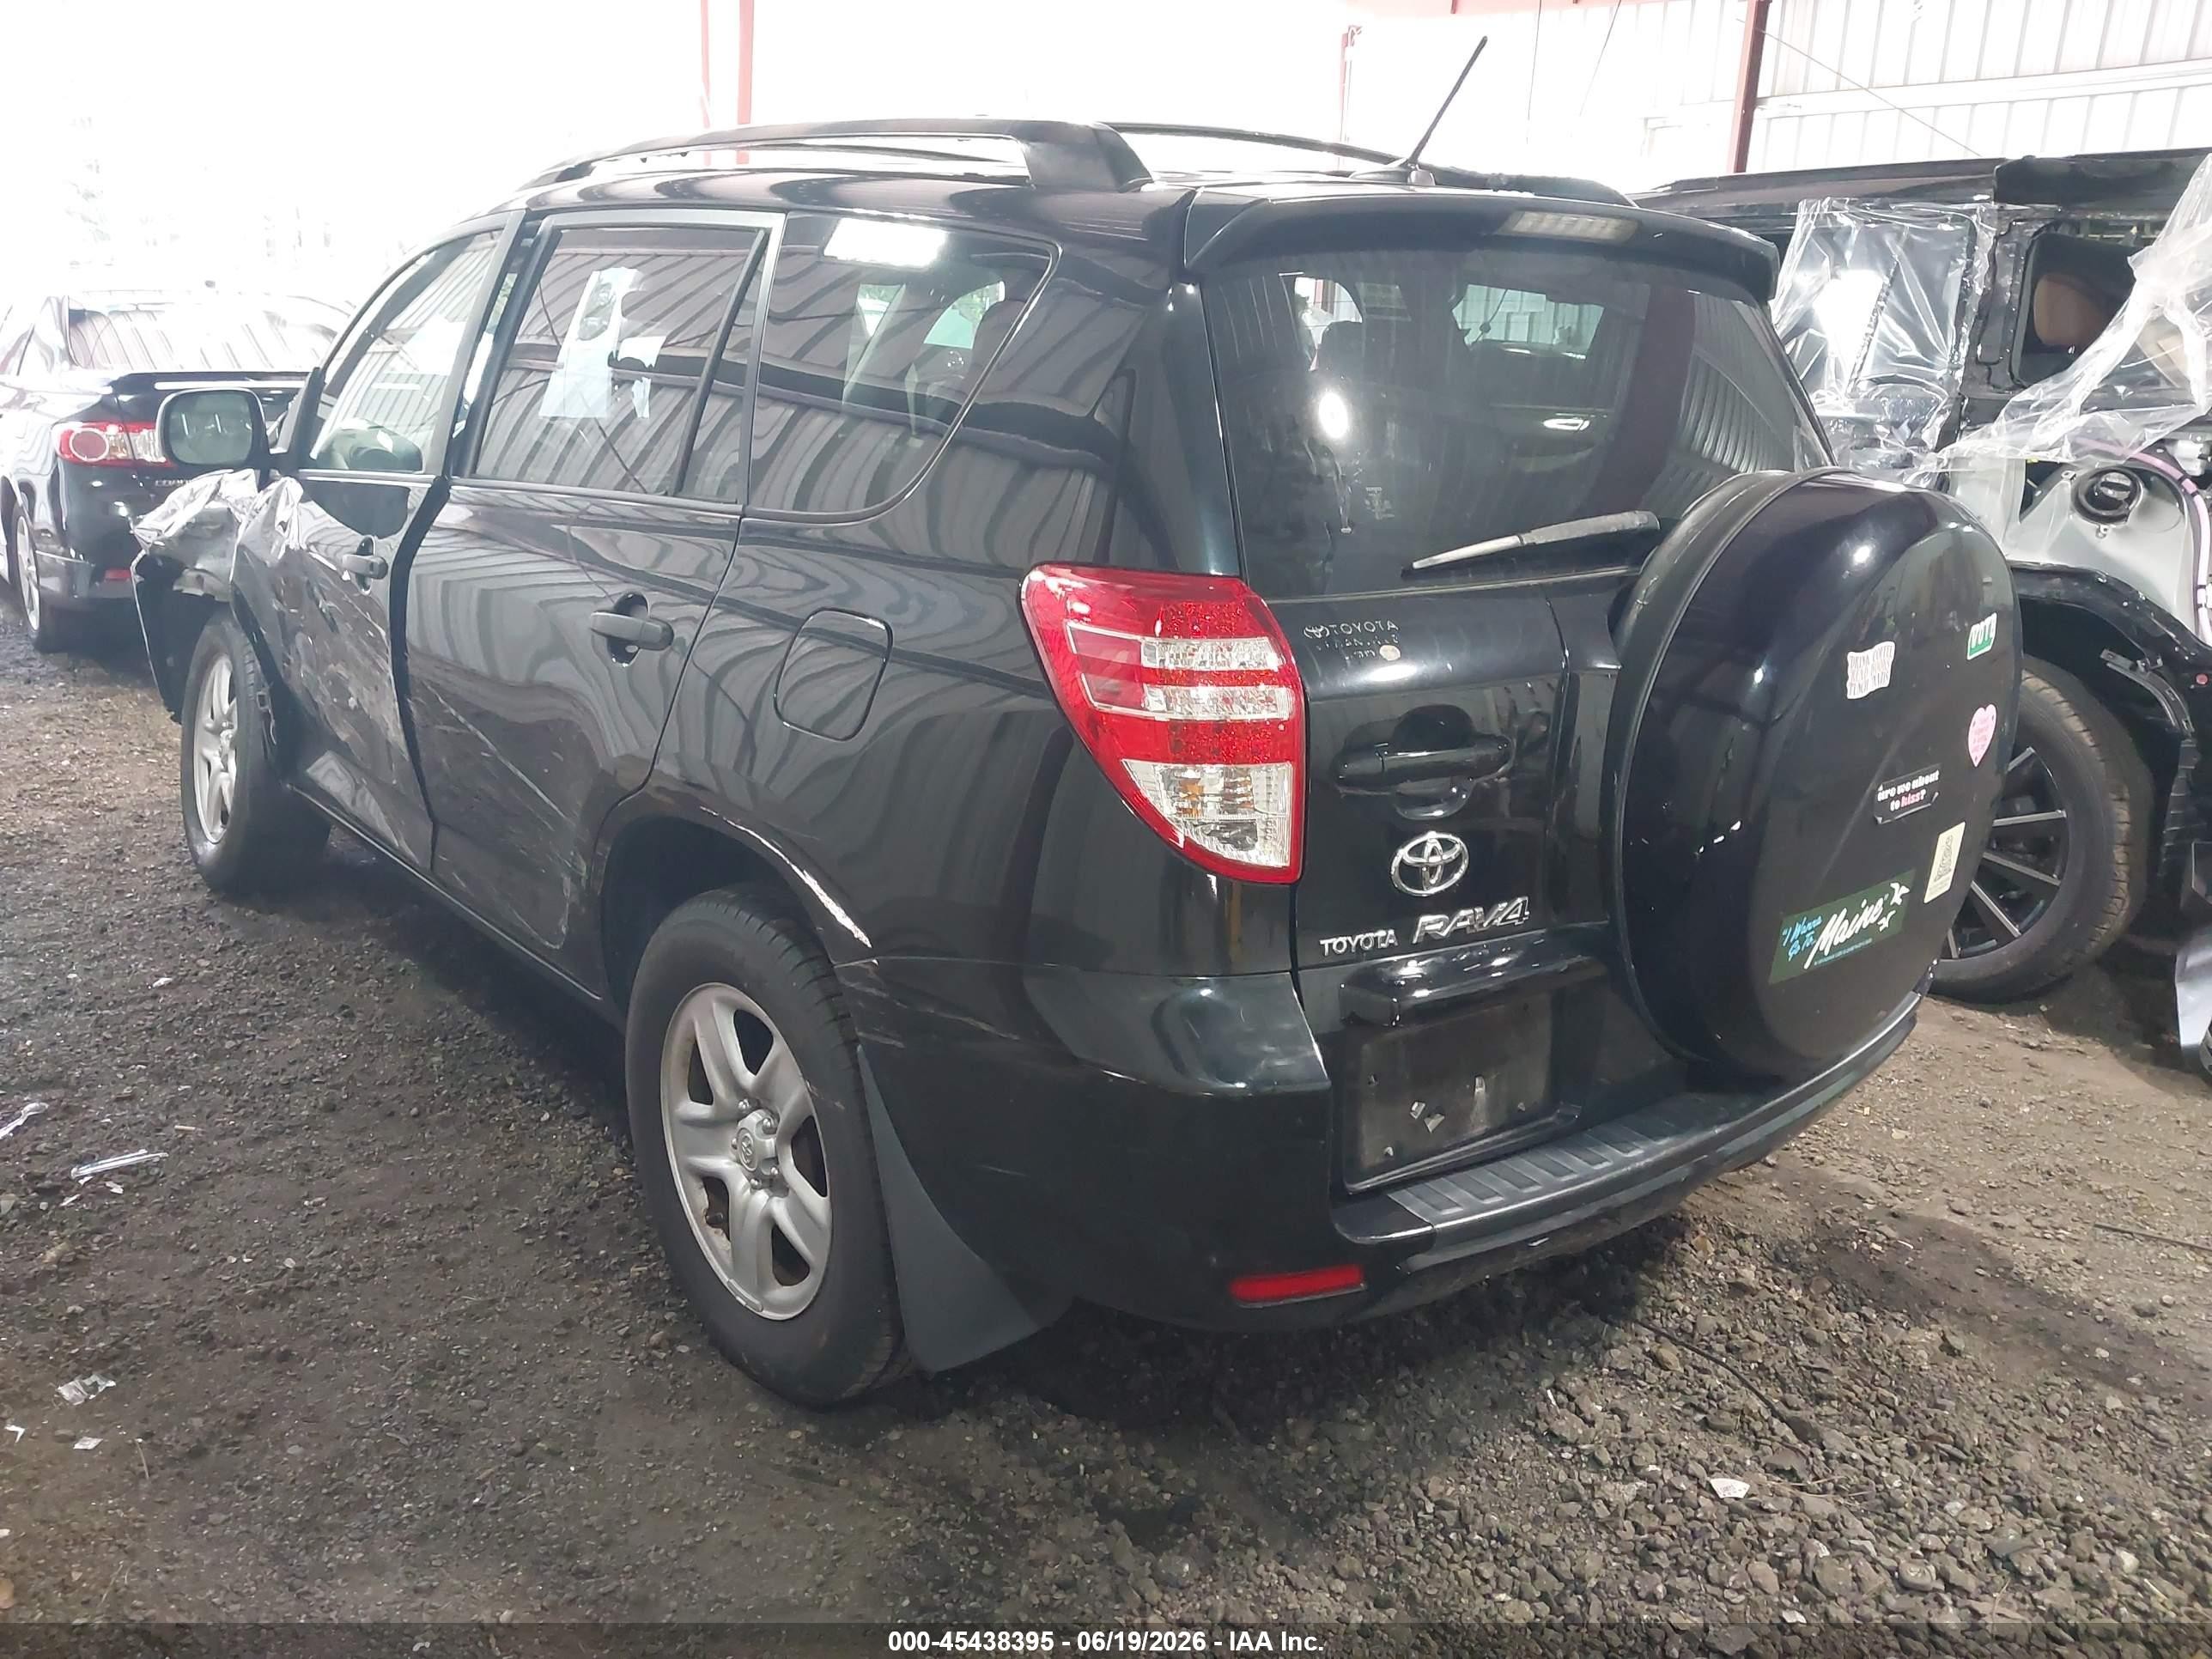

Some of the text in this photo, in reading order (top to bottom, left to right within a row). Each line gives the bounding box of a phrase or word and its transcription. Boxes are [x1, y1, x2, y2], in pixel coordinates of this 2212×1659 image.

[1328, 620, 1399, 635] TOYOTA
[1877, 769, 1940, 802] are we about
[1890, 788, 1927, 811] to kiss?
[1319, 896, 1530, 957] TOYOTA RAV4
